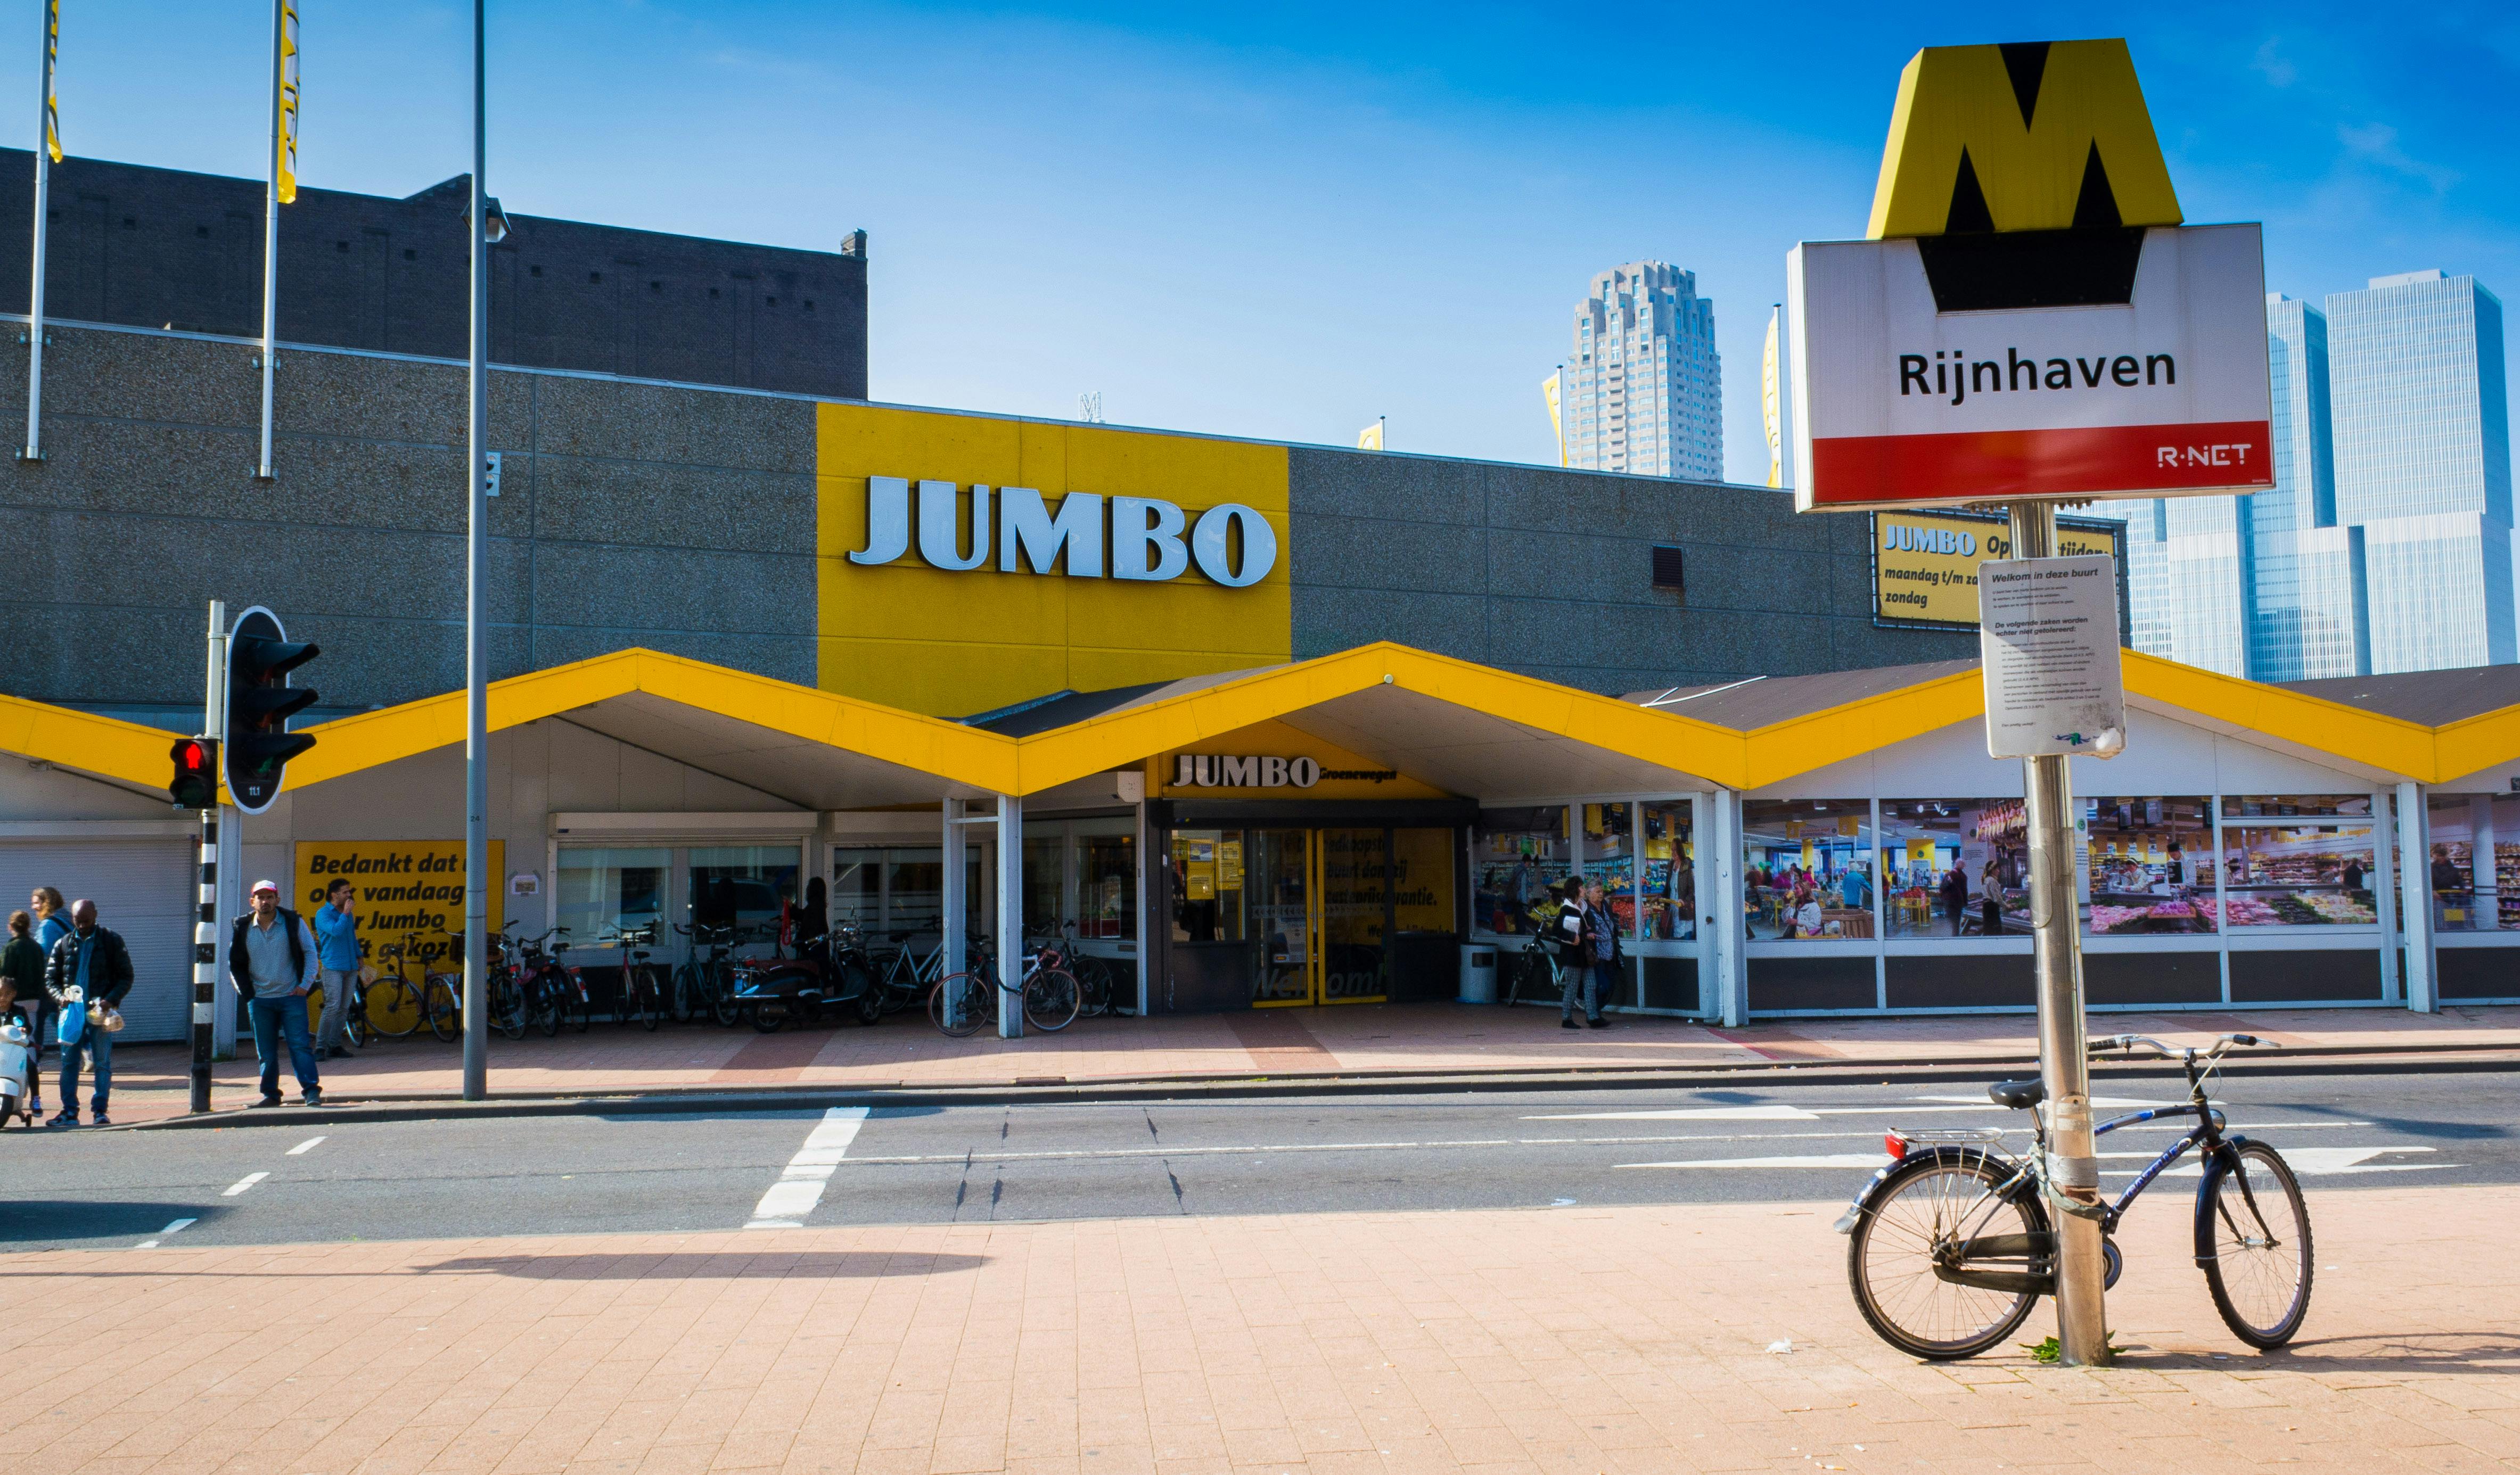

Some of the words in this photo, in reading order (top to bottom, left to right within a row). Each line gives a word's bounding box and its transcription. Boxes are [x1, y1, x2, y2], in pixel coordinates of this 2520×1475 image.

[1899, 348, 2176, 406] Rijnhaven
[849, 475, 1277, 588] JUMBO
[1884, 524, 1977, 557] JUMBO
[1885, 568, 1939, 586] maandag
[1942, 570, 1964, 586] t/m
[1992, 573, 2031, 583] Welkom
[2046, 570, 2068, 579] deze
[2071, 568, 2098, 578] buurt
[1885, 590, 1928, 609] zondag
[2006, 620, 2038, 629] volgende
[1173, 754, 1320, 788] JUMBO
[1320, 767, 1397, 784] Groenewegen
[309, 852, 413, 874] Bedankt
[417, 852, 458, 873] dat
[363, 880, 466, 907] vandaag
[367, 908, 446, 930] Jumbo
[1252, 962, 1385, 998] Welom!
